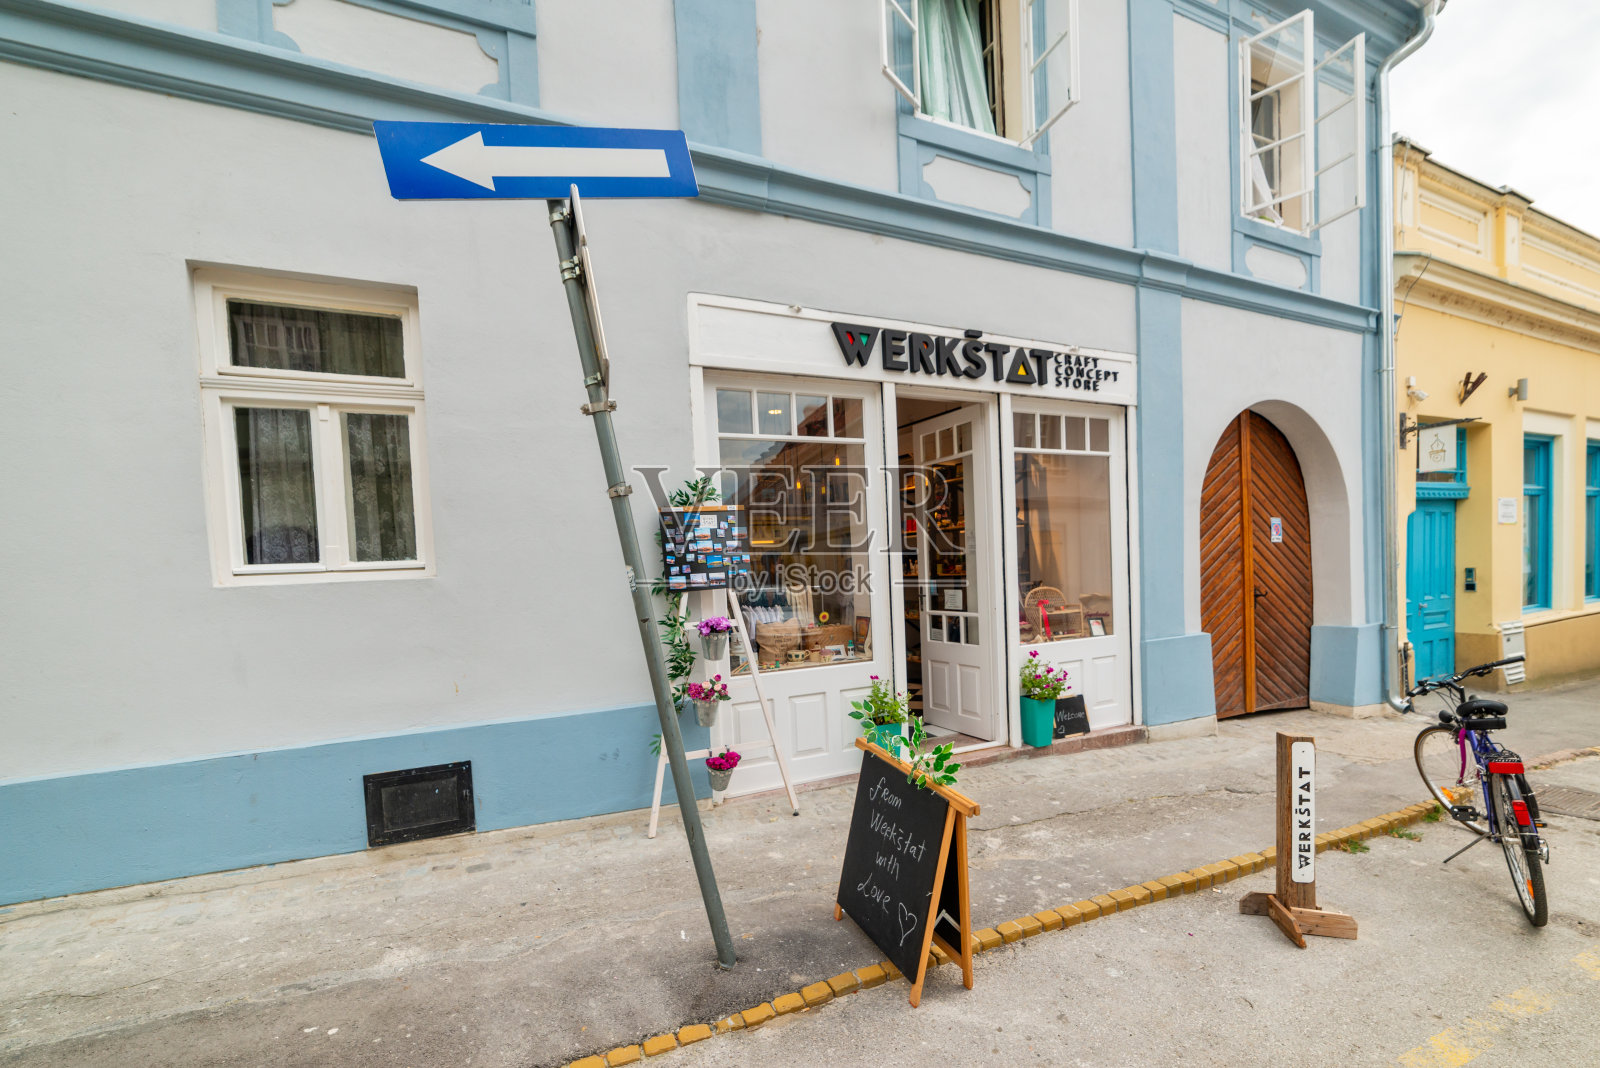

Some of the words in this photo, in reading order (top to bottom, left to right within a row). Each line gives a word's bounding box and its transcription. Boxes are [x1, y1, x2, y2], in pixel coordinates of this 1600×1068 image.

[1054, 353, 1099, 368] CRAFT
[1054, 364, 1119, 382] CONCEPT
[1055, 375, 1100, 392] STORE
[875, 850, 900, 881] with
[857, 872, 891, 914] Love
